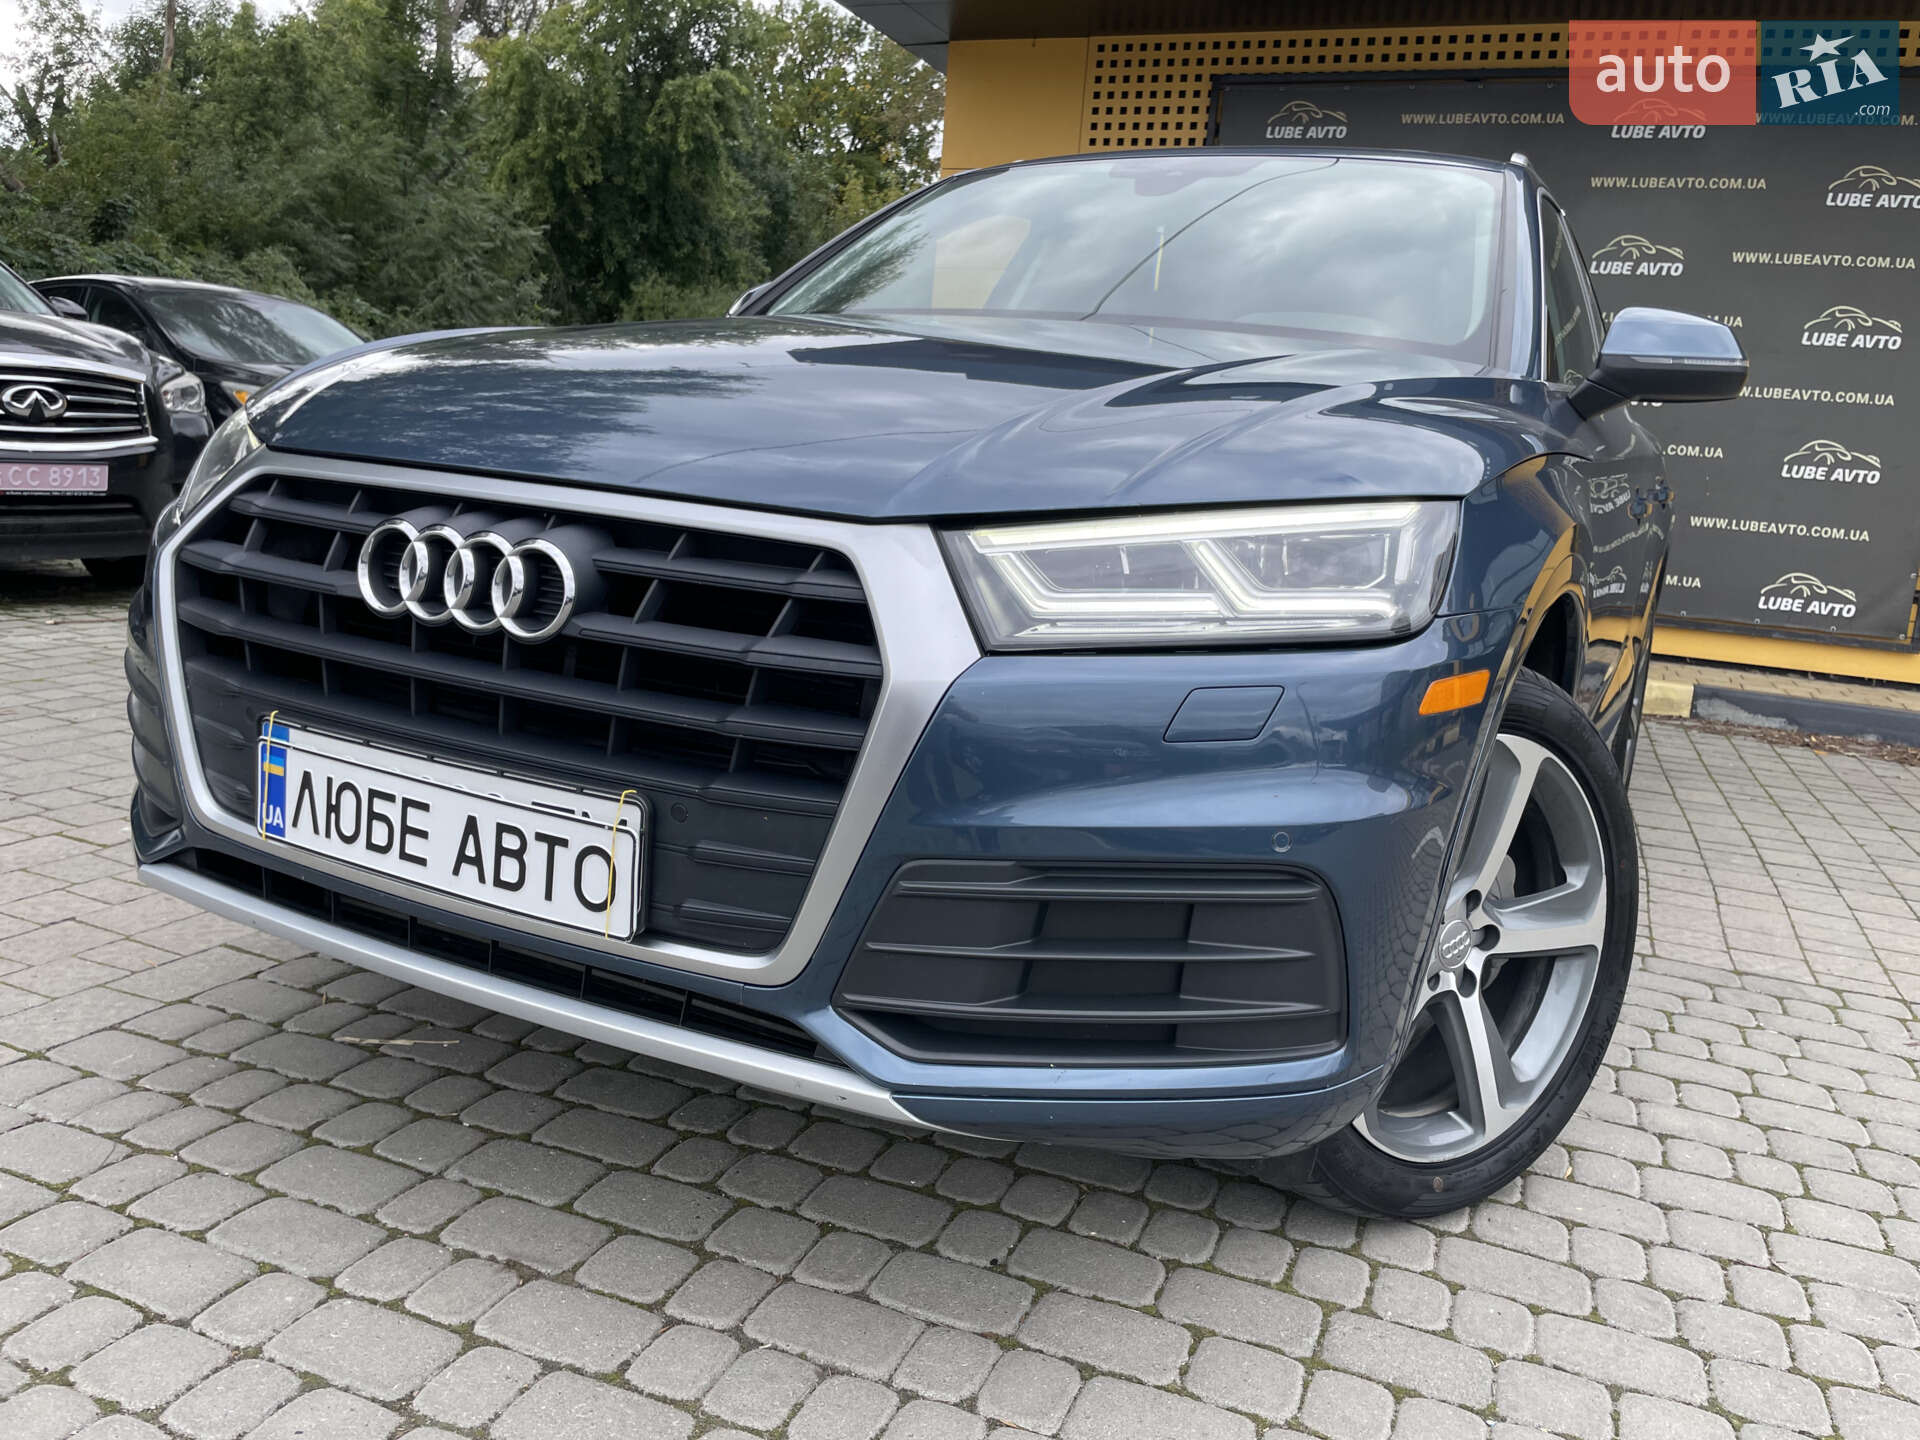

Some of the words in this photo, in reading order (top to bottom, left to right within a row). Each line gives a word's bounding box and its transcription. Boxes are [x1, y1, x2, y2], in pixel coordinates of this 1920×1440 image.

[1401, 112, 1565, 125] WWW.LUBEAVTO.COM.UA
[1265, 126, 1302, 139] LUBE
[1306, 126, 1348, 139] AVTO
[1610, 125, 1654, 139] LUBE
[1658, 125, 1706, 139] AVTO
[1590, 176, 1767, 190] WWW.LUBEAVTO.COM.UA
[1825, 192, 1874, 207] LUBE
[1590, 261, 1632, 275] LUBE
[1636, 261, 1684, 277] AVTO
[1732, 251, 1916, 270] WWW.LUBEAVTO.COM.UA
[1801, 331, 1849, 347] LUBE
[1850, 333, 1902, 350] AVTO
[48, 466, 101, 487] 8913
[1781, 464, 1829, 481] LUBE
[1830, 467, 1881, 485] AVTO
[1690, 515, 1870, 542] WWW.LUBEAVTO.COM.UA
[1758, 596, 1805, 613] LUBE
[1806, 600, 1857, 618] AVTO
[263, 803, 284, 829] UA
[292, 770, 431, 868] ЛЮБЕ
[451, 814, 617, 913] АВТО
